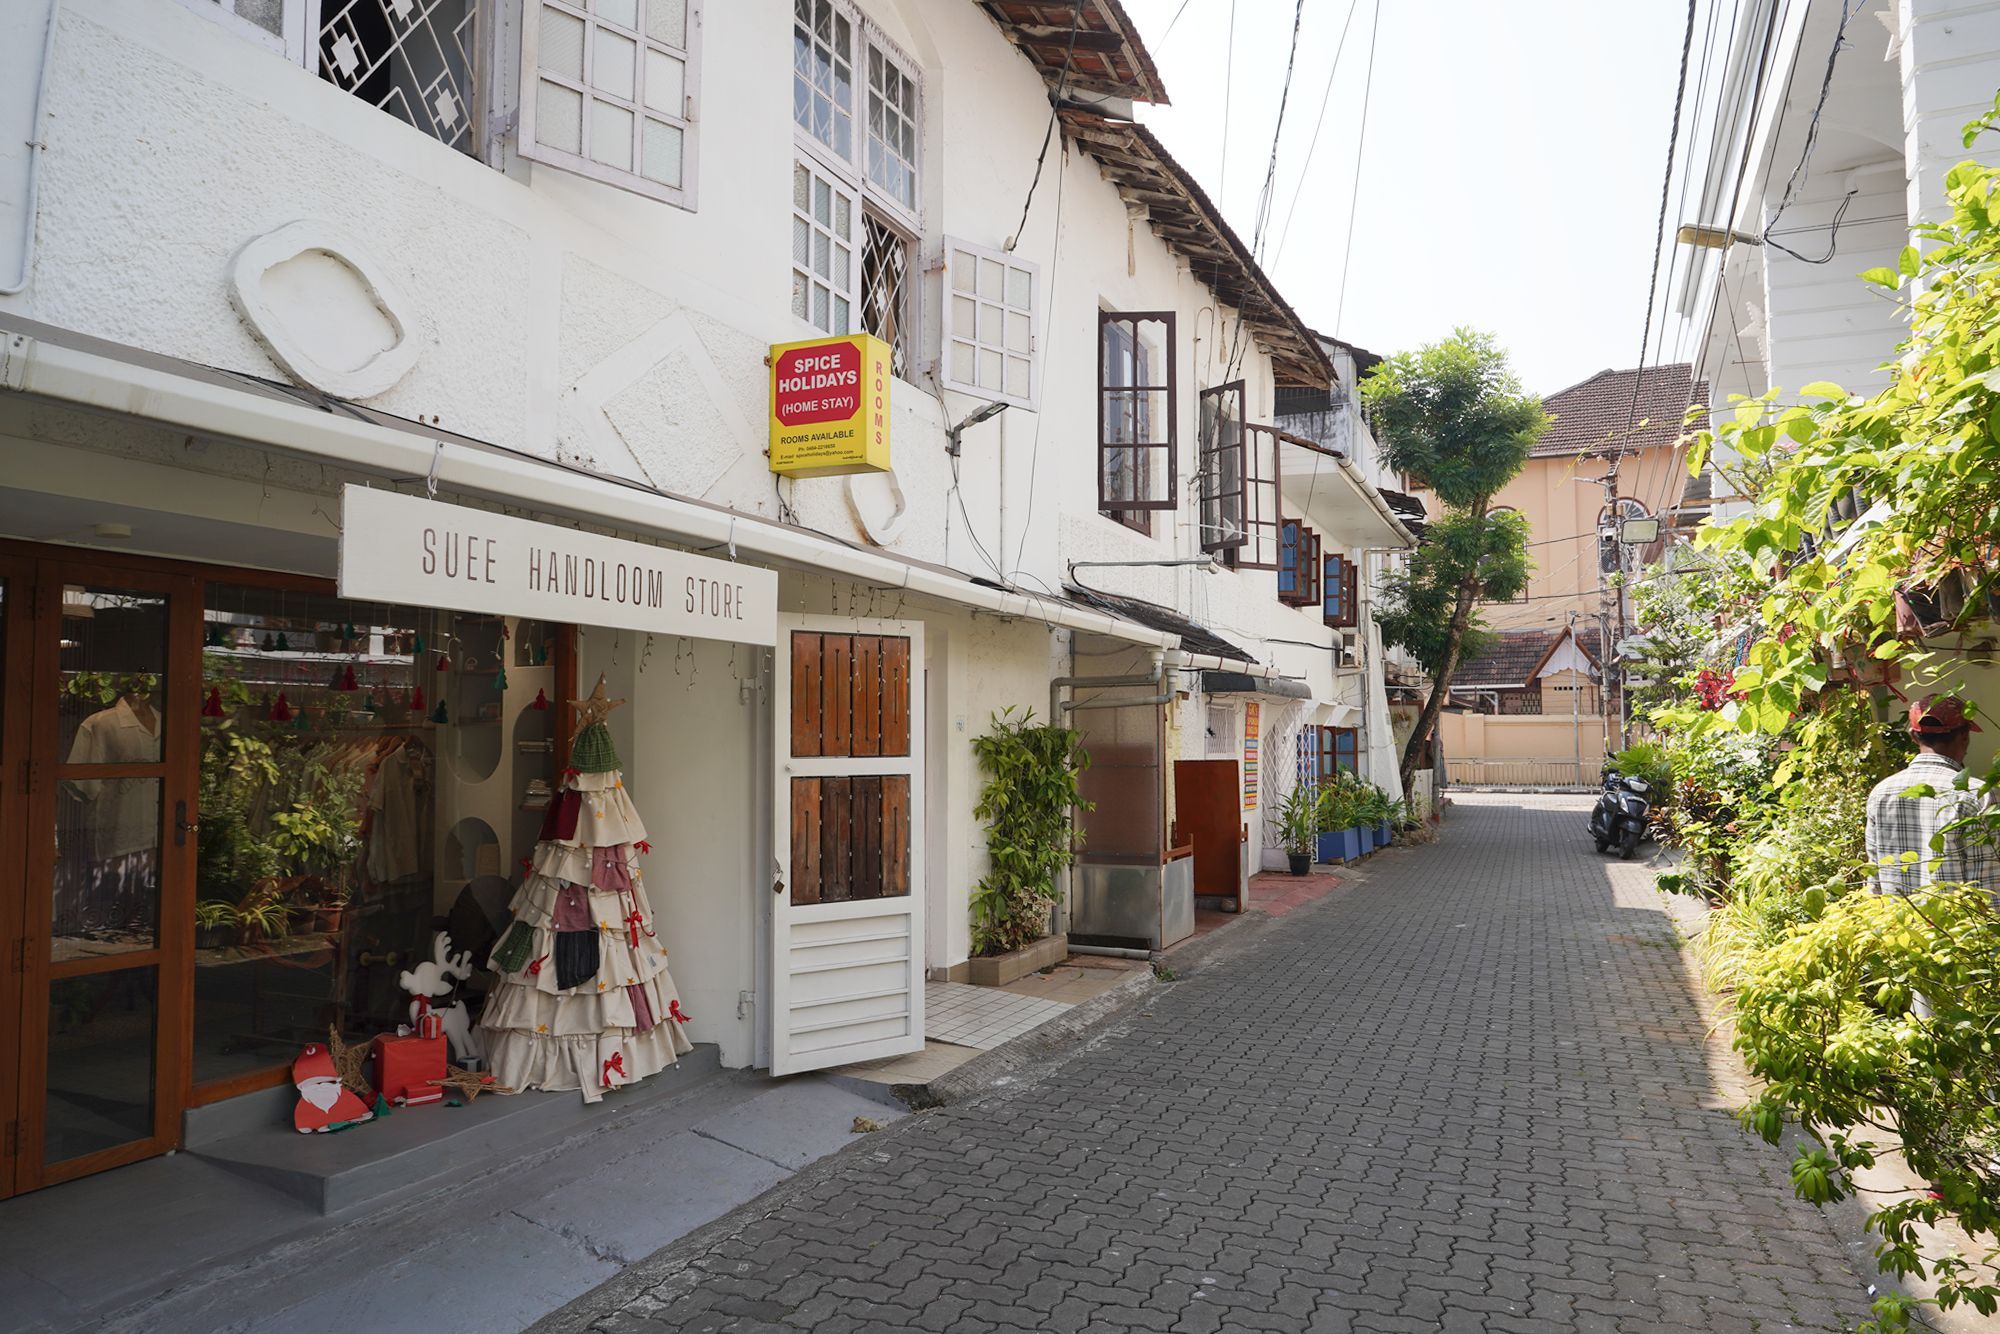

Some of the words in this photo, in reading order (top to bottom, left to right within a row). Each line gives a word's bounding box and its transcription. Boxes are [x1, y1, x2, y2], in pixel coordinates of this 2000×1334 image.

[794, 354, 841, 374] SPICE
[778, 370, 857, 393] HOLIDAYS
[781, 400, 819, 416] (HOME
[821, 396, 854, 410] STAY)
[875, 361, 883, 445] ROOMS
[780, 434, 809, 445] ROOMS
[811, 429, 854, 442] AVAILABLE
[422, 527, 497, 585] SUEE
[529, 547, 663, 609] HANDLOOM
[685, 576, 744, 621] STORE
